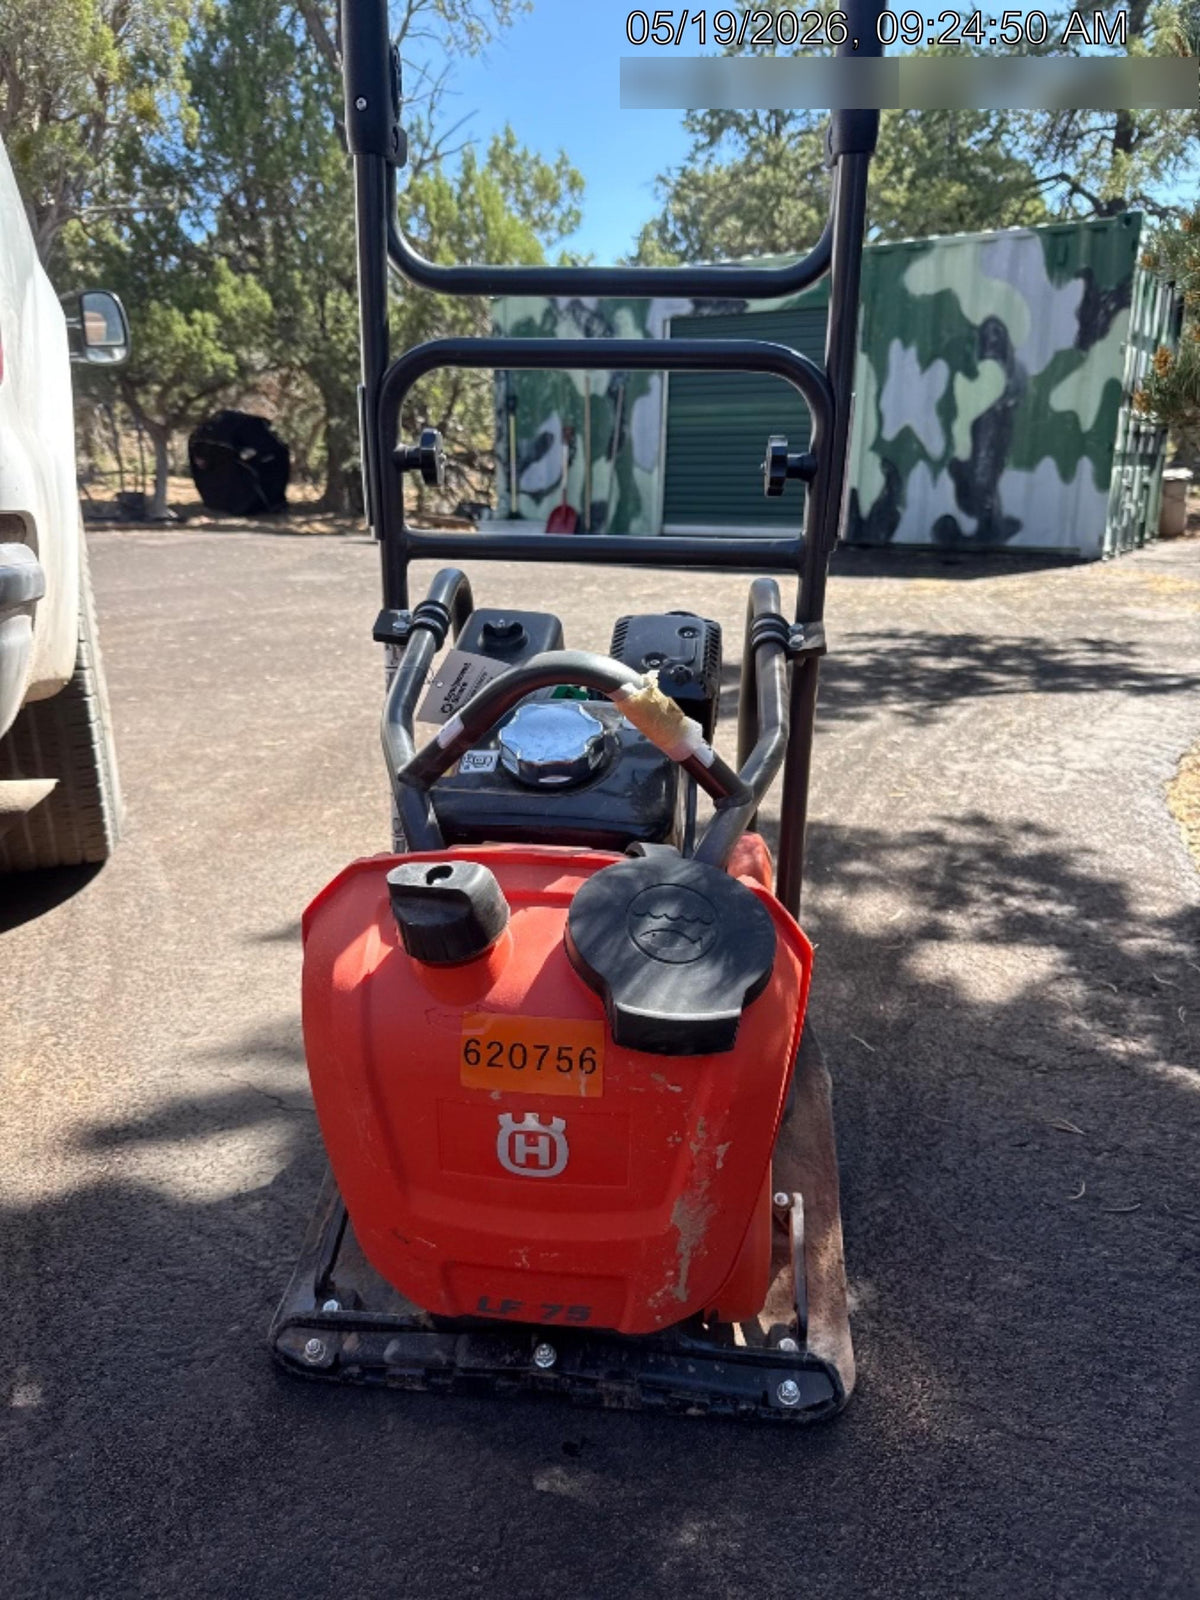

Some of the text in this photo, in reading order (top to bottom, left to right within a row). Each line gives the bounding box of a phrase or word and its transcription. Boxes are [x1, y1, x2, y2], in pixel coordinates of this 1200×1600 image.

[463, 1038, 597, 1075] 620756
[477, 1295, 593, 1322] LF 75
